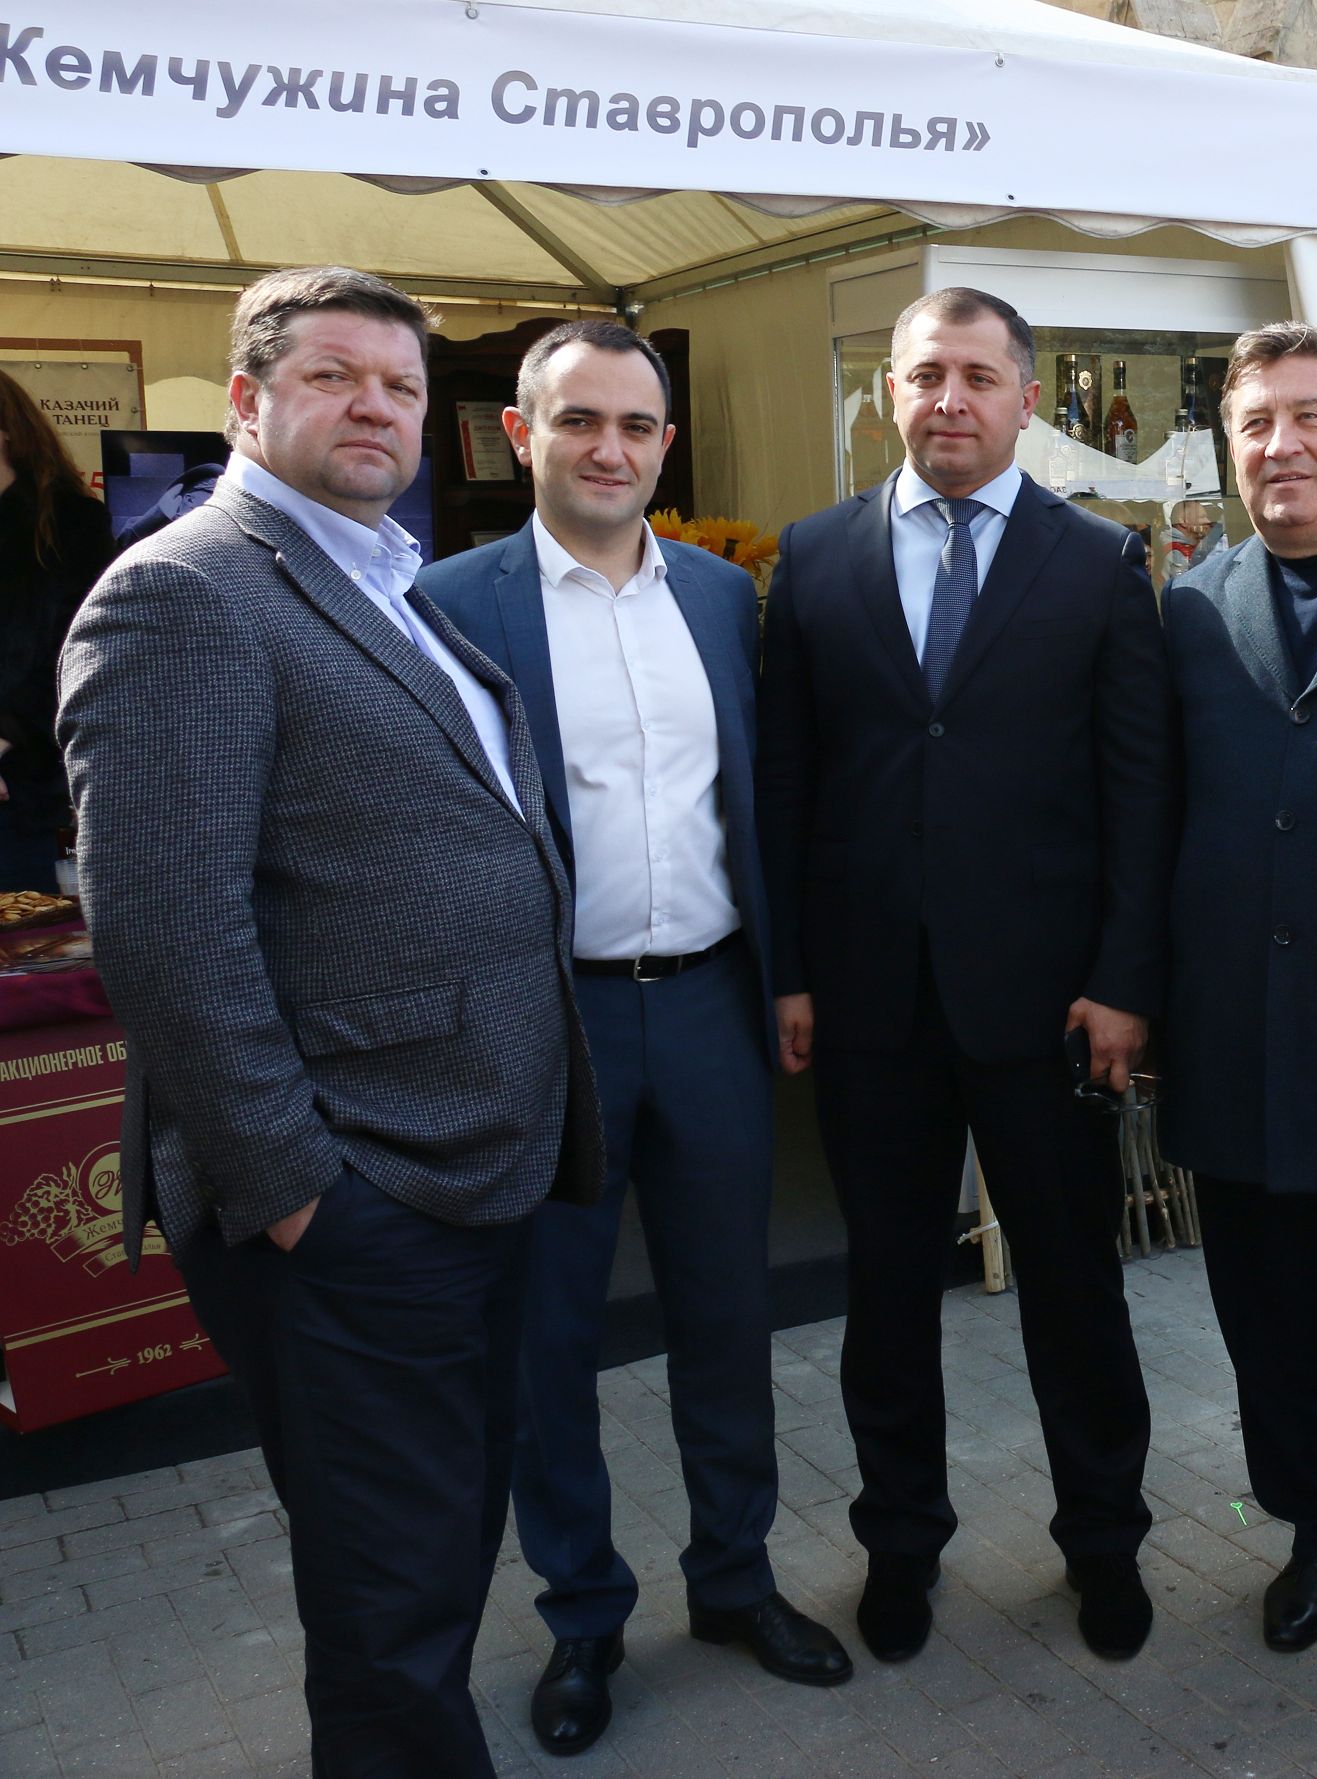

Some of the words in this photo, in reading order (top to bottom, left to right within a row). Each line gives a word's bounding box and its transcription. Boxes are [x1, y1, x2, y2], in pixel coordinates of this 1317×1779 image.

[491, 70, 992, 153] Ставрополья»
[40, 397, 120, 411] КАЗАЧИЙ
[53, 414, 110, 427] ТАНЕЦ
[0, 1045, 104, 1081] АКЦИОНЕРНОЕ
[106, 1040, 128, 1062] ОБ
[136, 1344, 173, 1364] 1962
